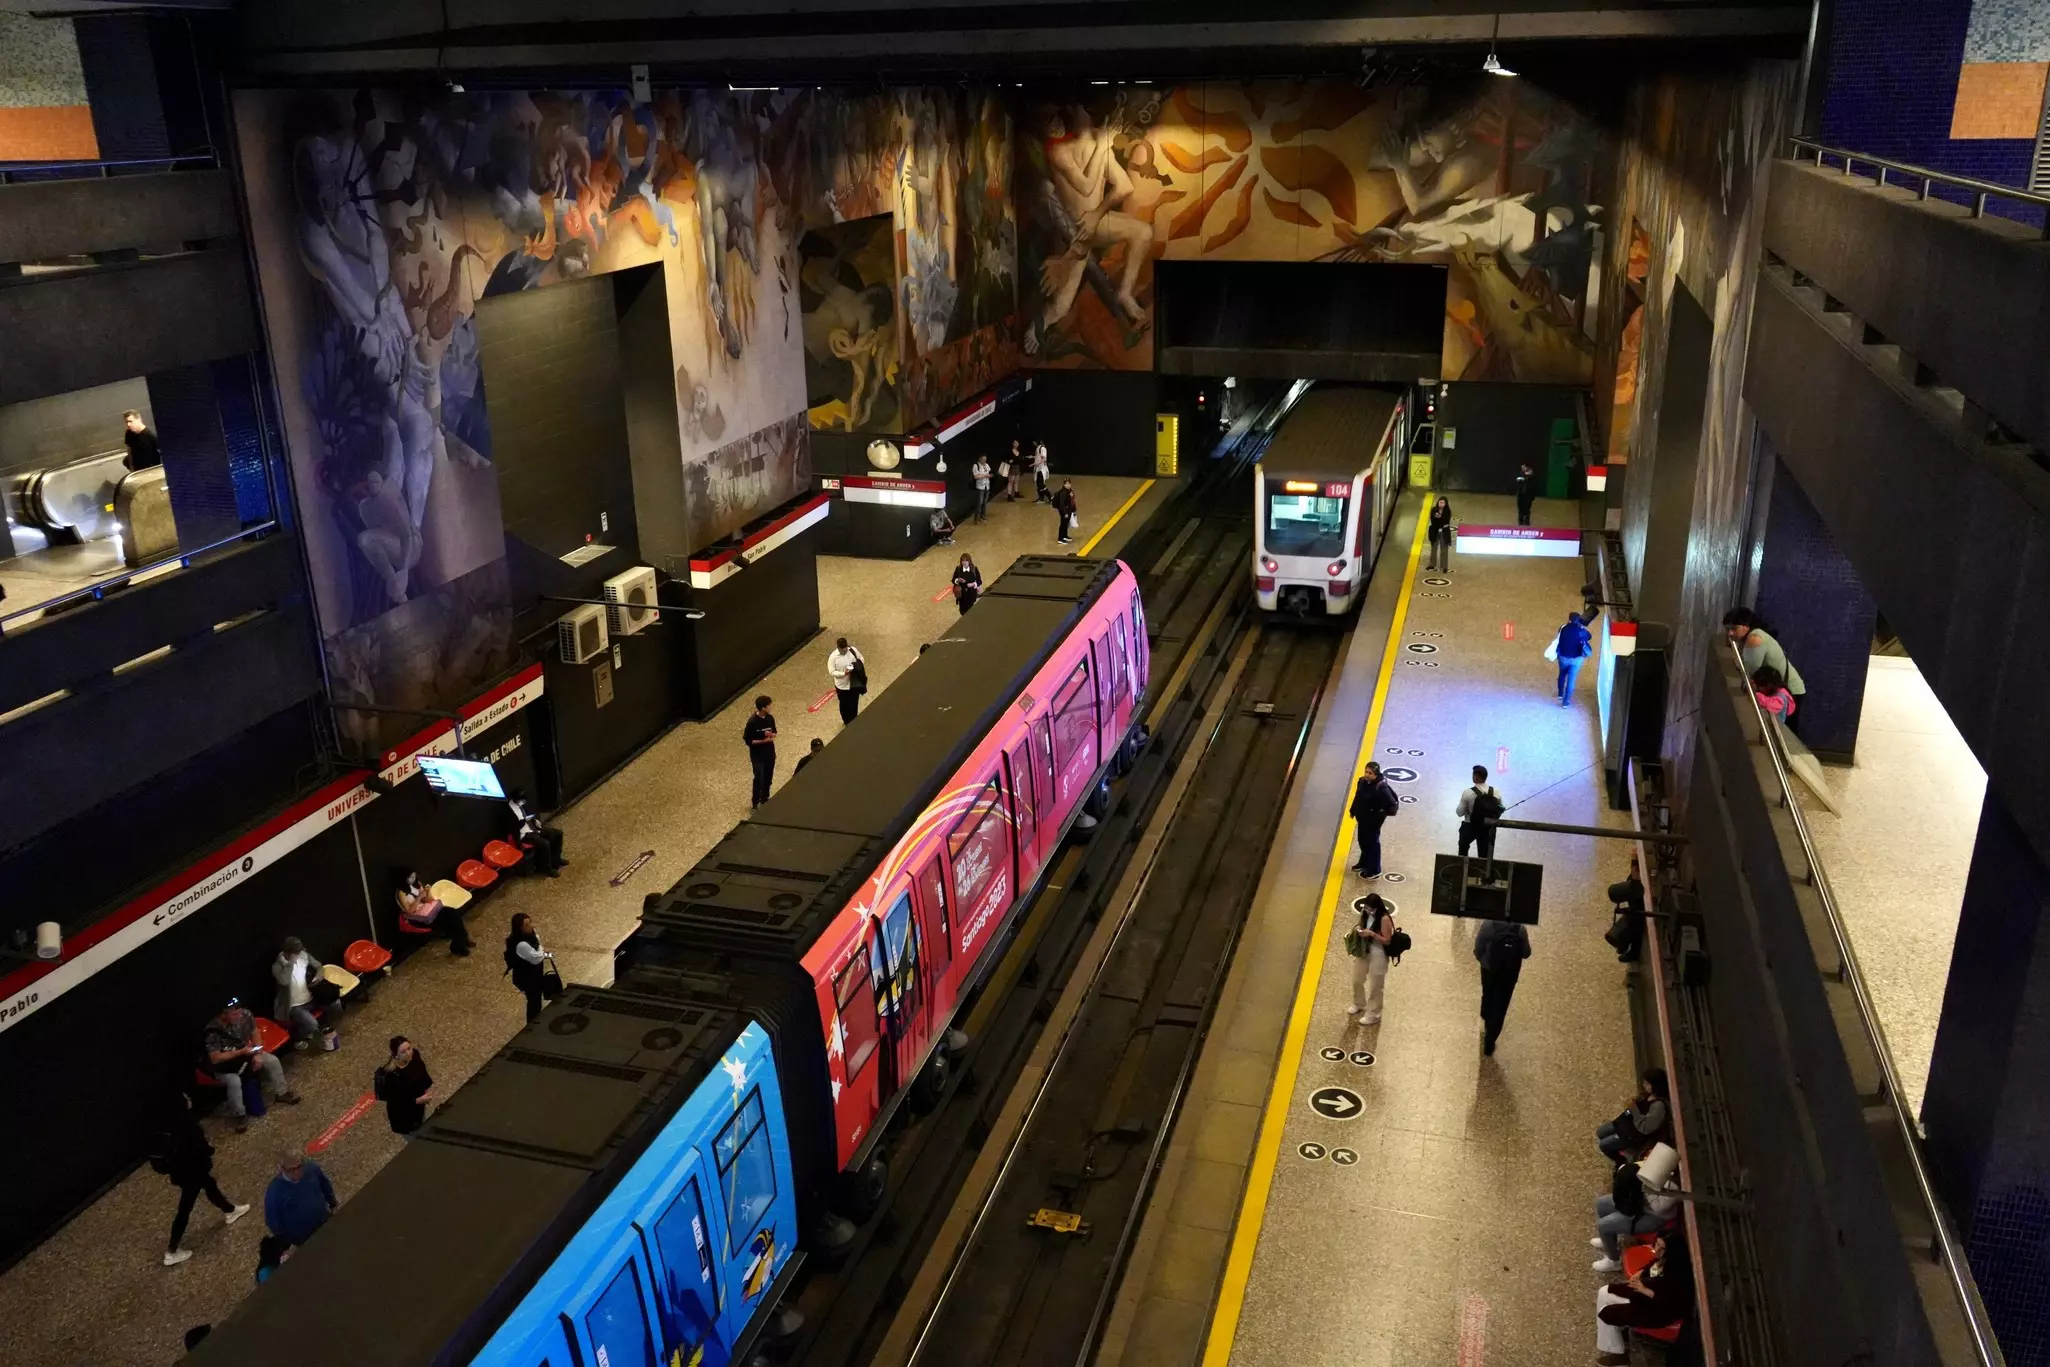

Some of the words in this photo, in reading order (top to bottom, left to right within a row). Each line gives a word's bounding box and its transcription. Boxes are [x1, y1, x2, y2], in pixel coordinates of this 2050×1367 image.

[1331, 484, 1349, 496] 104
[464, 717, 483, 736] Salida
[484, 715, 489, 724] a
[490, 702, 509, 720] Estado
[490, 748, 501, 764] DE
[501, 734, 522, 757] CHILE
[397, 763, 409, 779] DE
[168, 868, 239, 916] Combinación
[0, 993, 39, 1023] Pablo
